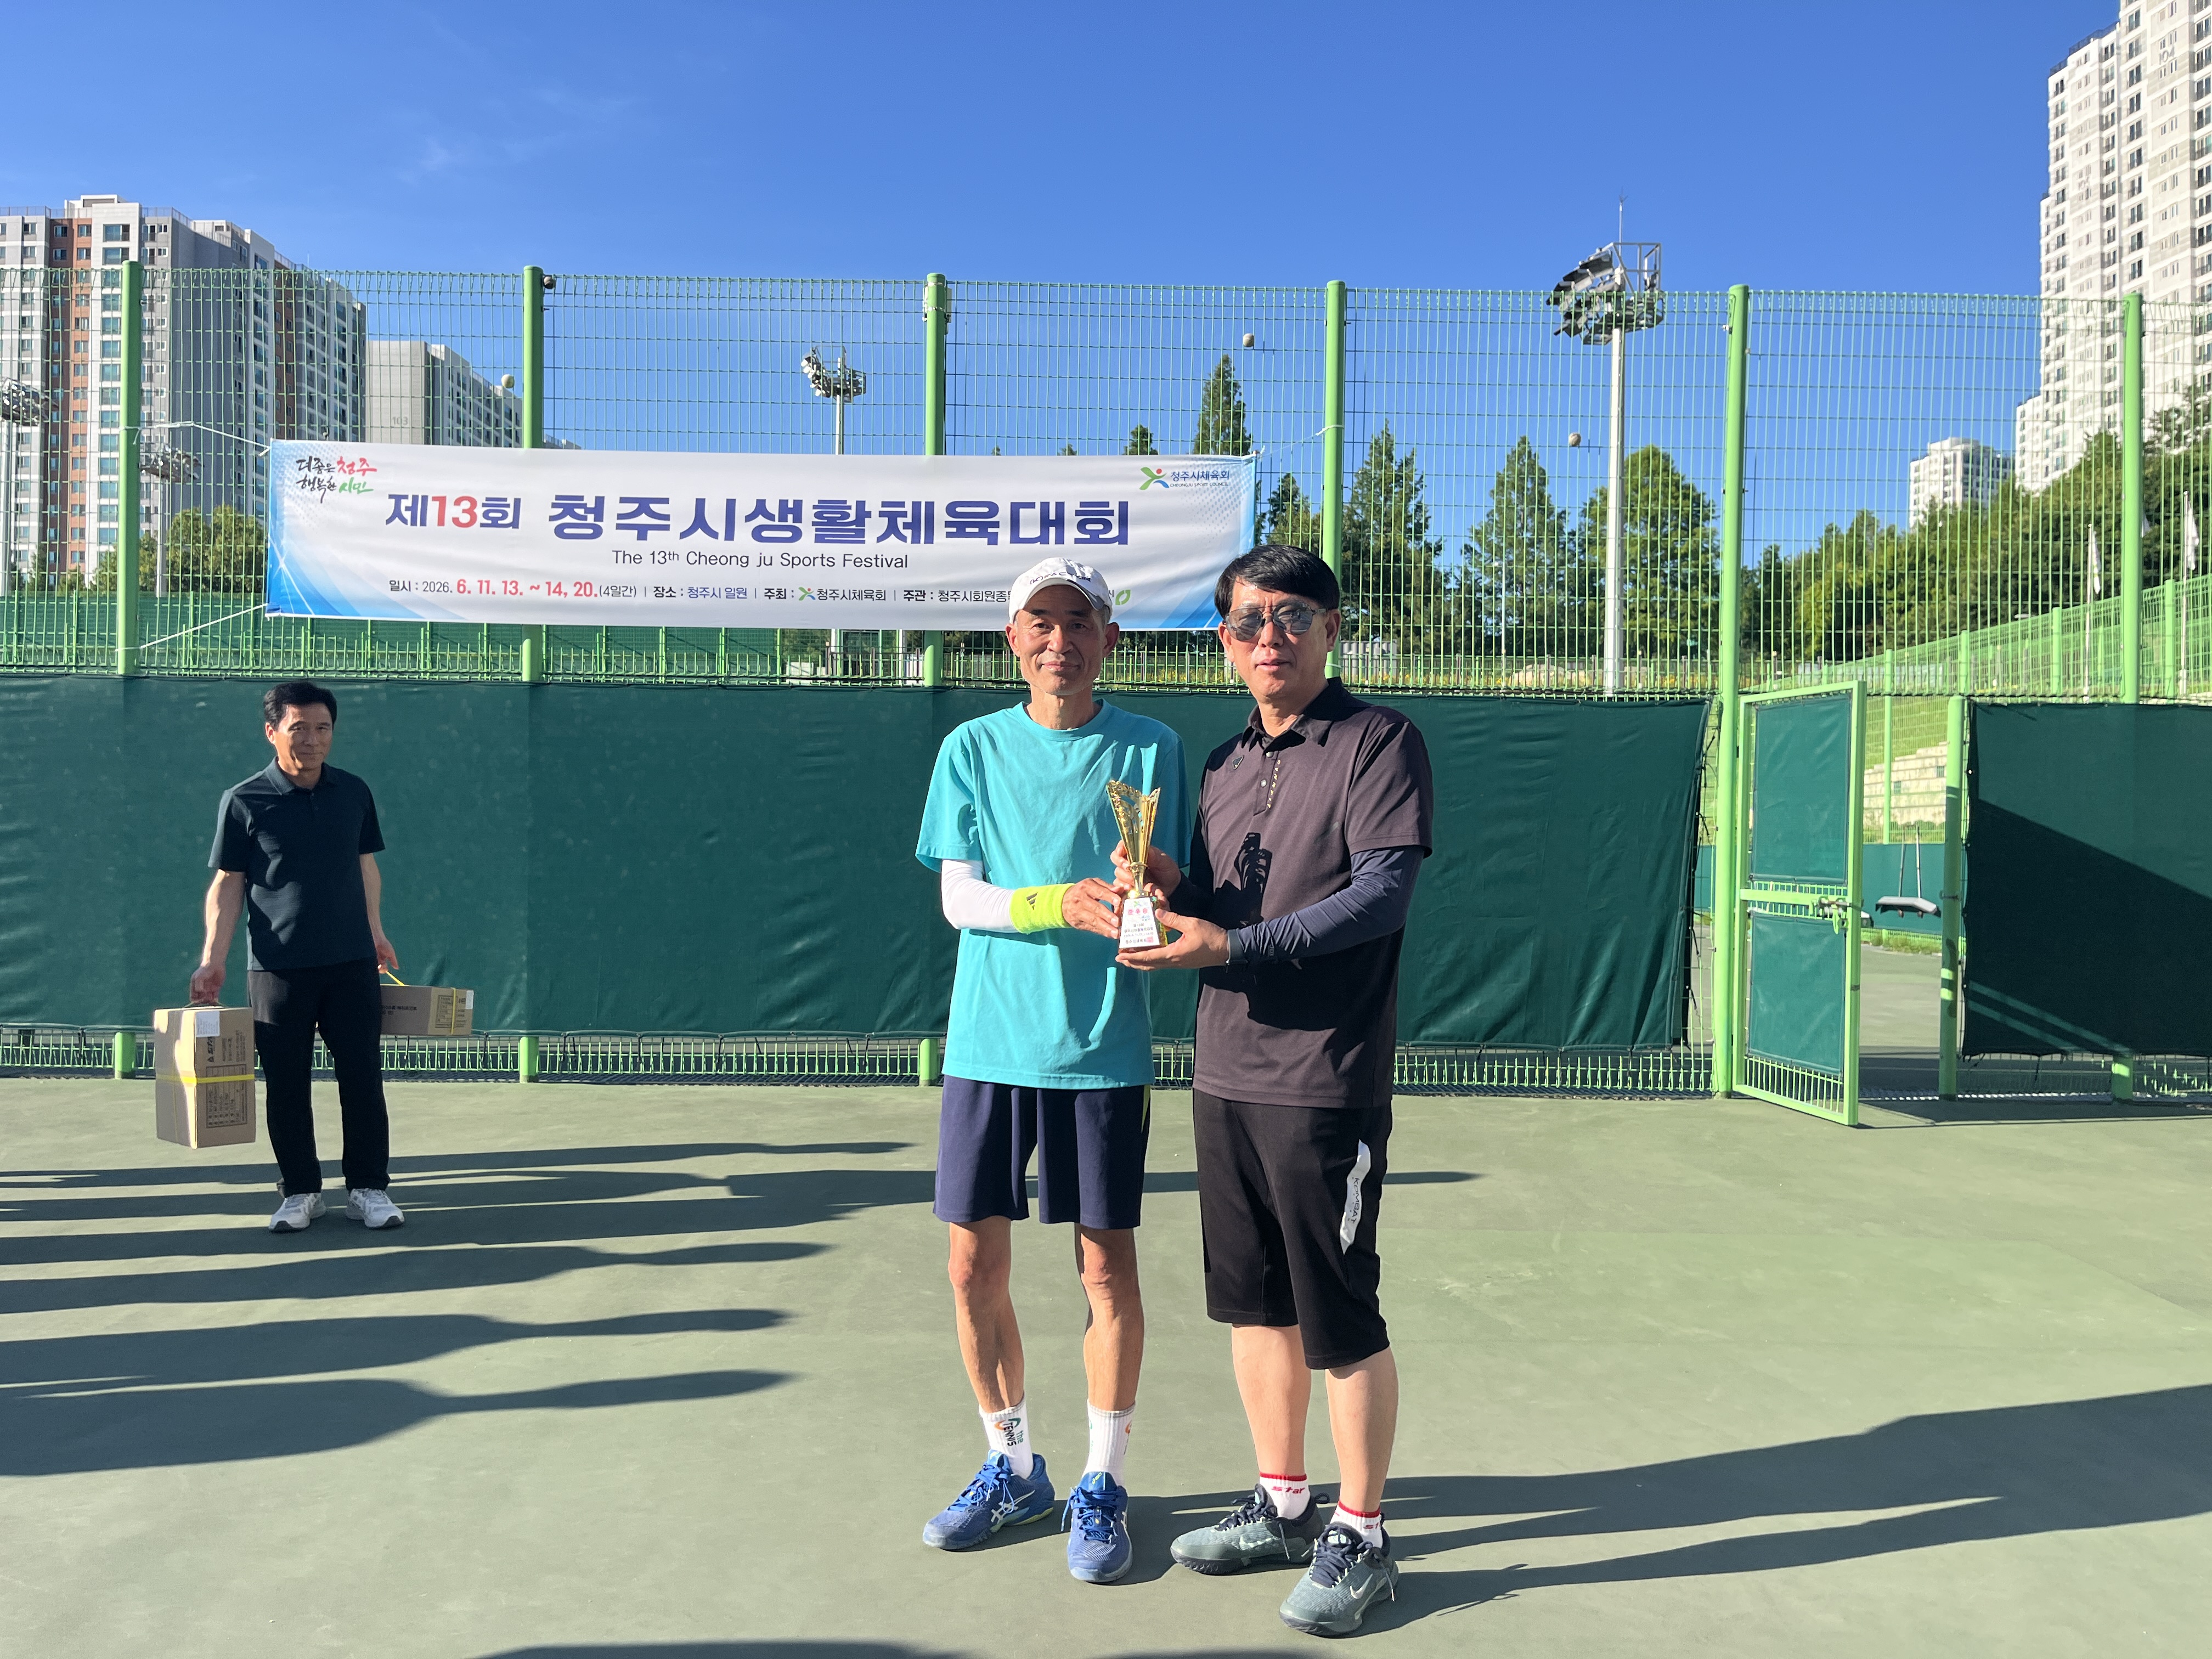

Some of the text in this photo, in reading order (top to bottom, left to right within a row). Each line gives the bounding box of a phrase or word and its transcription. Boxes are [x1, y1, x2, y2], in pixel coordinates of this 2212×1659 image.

[2159, 46, 2175, 65] 104
[336, 456, 377, 477] 청주
[1170, 470, 1230, 482] 청주시체육회
[296, 474, 374, 504] 행복한 시민
[385, 493, 1129, 546] 제13회 청주시생활체육대회
[612, 550, 908, 568] The 13th Cheong ju Sports Festival
[422, 580, 453, 594] 2026.
[687, 586, 722, 599] 청주시
[724, 586, 748, 600] 일원
[816, 588, 887, 602] 청주시체육회
[938, 589, 1011, 603] 청주시회원종
[1350, 1177, 1360, 1224] KOMBAT
[1002, 1421, 1017, 1446] TENNIS
